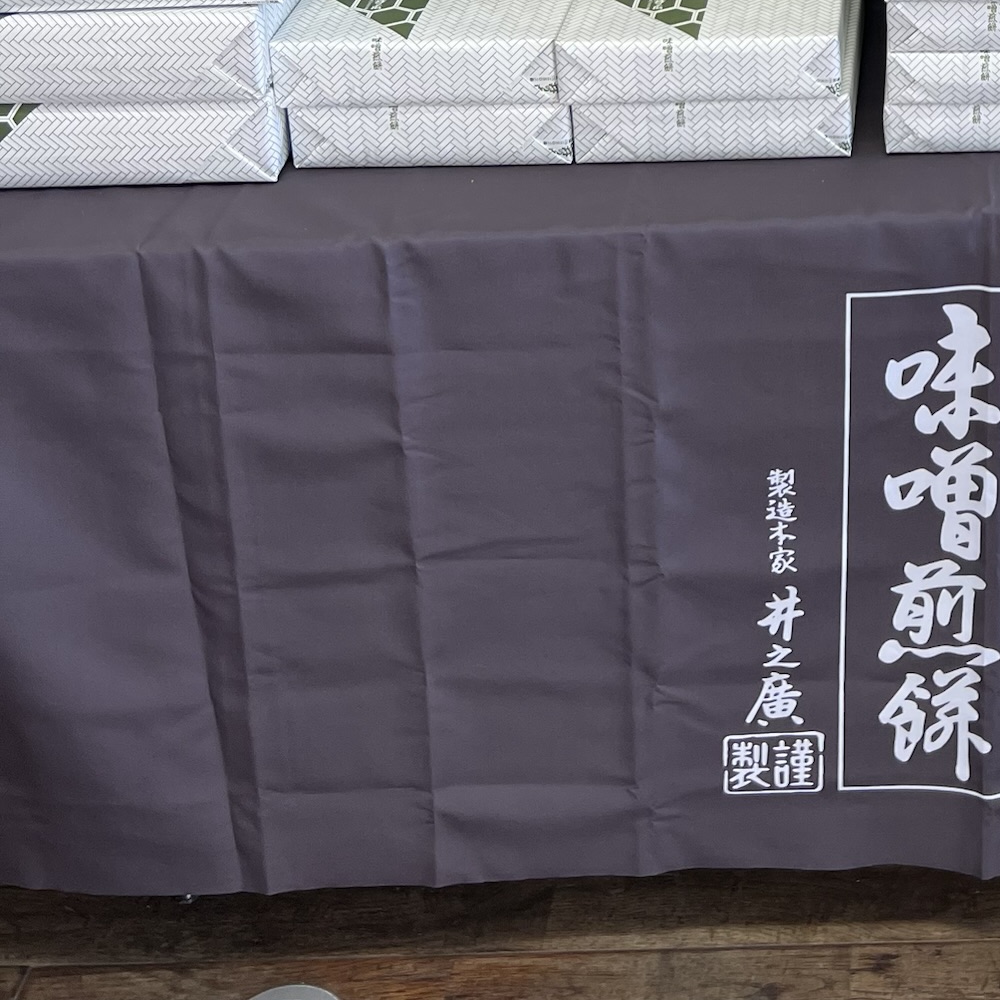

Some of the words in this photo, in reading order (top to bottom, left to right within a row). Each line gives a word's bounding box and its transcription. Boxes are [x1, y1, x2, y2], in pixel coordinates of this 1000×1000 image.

[765, 468, 798, 575] 製造本家
[745, 585, 805, 726] 井之廣
